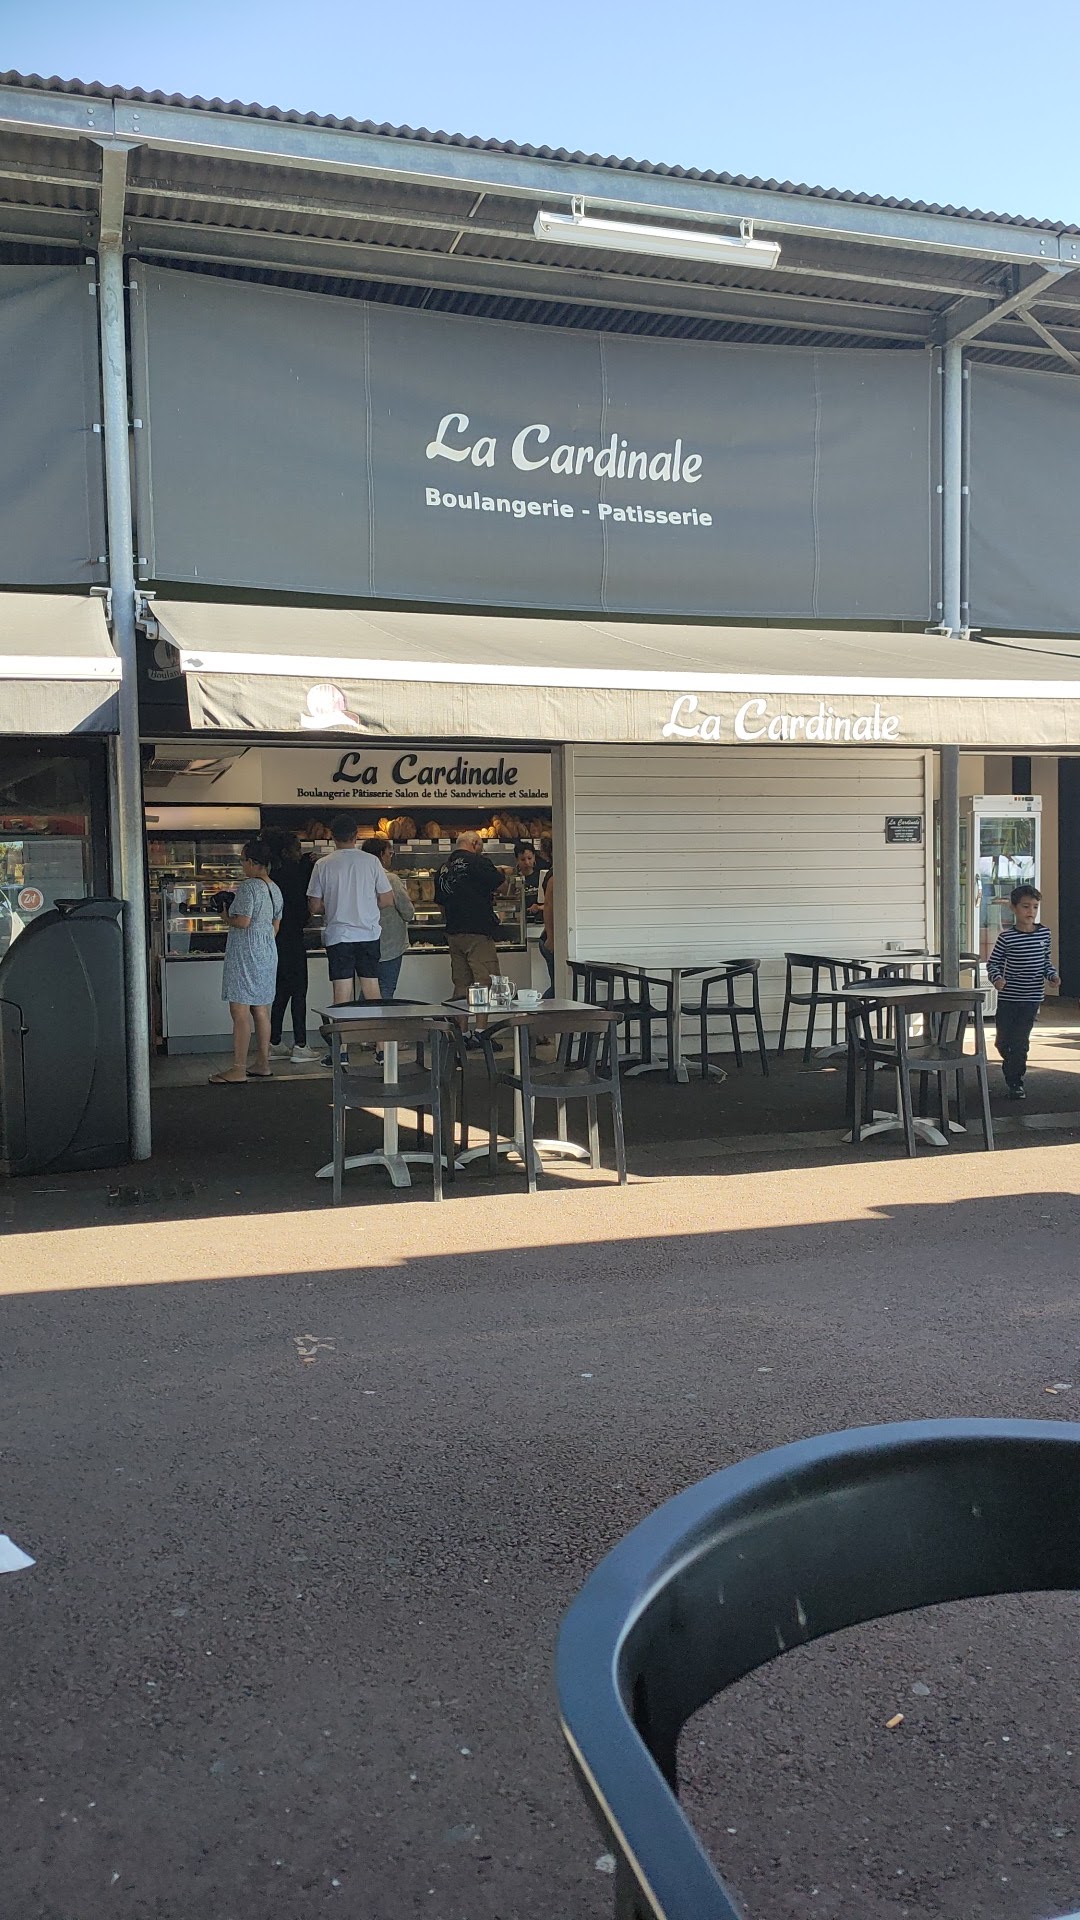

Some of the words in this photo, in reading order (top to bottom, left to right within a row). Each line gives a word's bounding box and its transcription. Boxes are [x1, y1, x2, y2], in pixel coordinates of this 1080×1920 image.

[425, 412, 497, 468] La
[511, 424, 703, 483] Cardinale
[425, 487, 574, 518] Boulangerie
[598, 503, 713, 526] Patisserie
[662, 694, 721, 741] La
[734, 698, 901, 742] Cardinale
[332, 751, 378, 785] La
[391, 753, 518, 786] Cardinale
[297, 787, 350, 800] Boulangerie
[352, 787, 393, 798] Pâtisserie
[395, 788, 419, 798] Salon
[422, 788, 432, 799] de
[433, 788, 448, 799] thé
[450, 788, 506, 799] Sandwicherie
[509, 790, 517, 799] et
[519, 788, 549, 799] Salades
